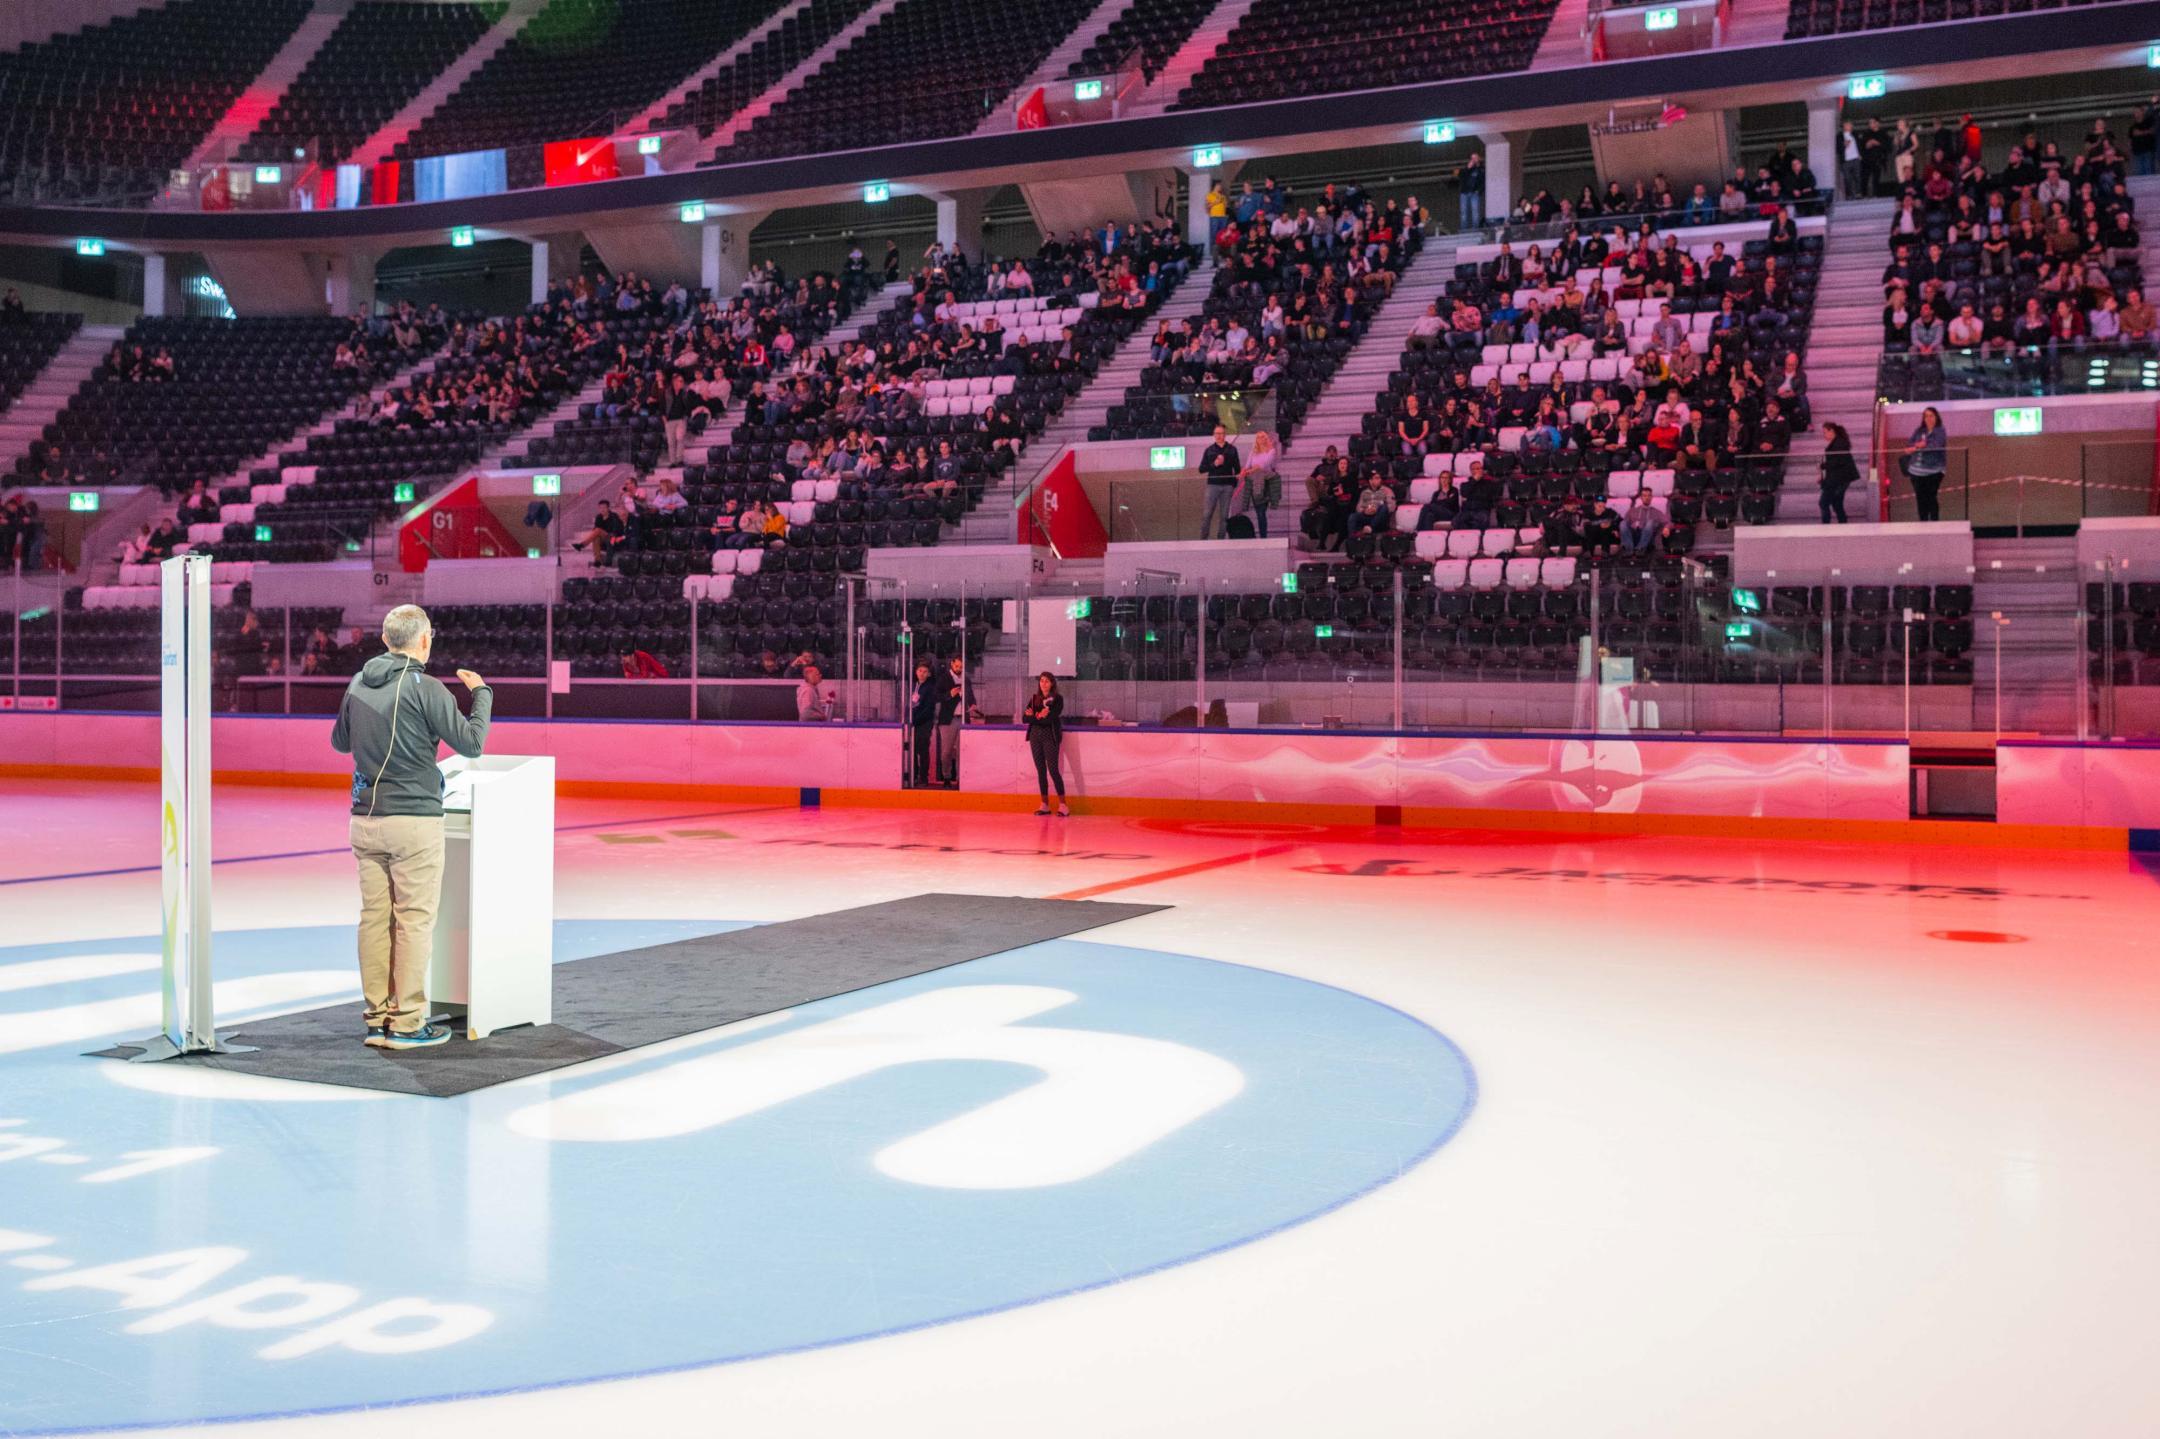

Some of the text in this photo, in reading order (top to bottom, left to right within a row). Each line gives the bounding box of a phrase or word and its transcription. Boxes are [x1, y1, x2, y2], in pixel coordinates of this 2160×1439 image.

[432, 511, 453, 531] G1
[1032, 559, 1044, 575] F4
[373, 572, 389, 586] G1
